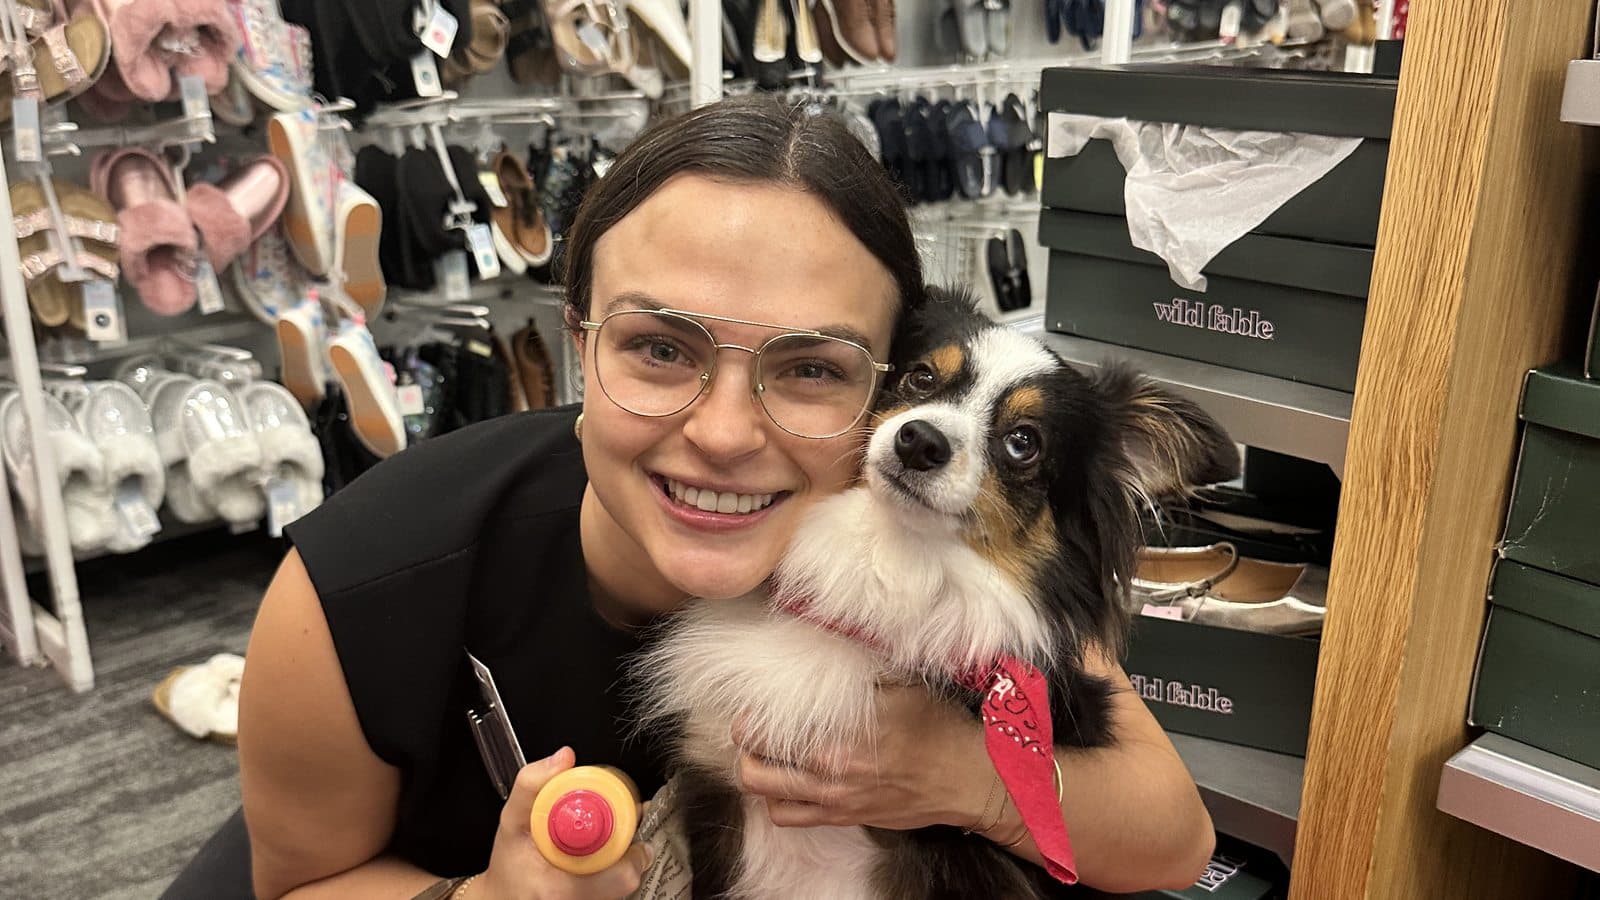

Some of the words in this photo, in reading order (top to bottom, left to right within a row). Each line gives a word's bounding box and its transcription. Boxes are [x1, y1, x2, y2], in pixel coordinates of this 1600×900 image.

[1153, 298, 1203, 328] wild
[1208, 304, 1274, 340] fable
[1129, 673, 1162, 701] ild
[1166, 681, 1233, 714] fable
